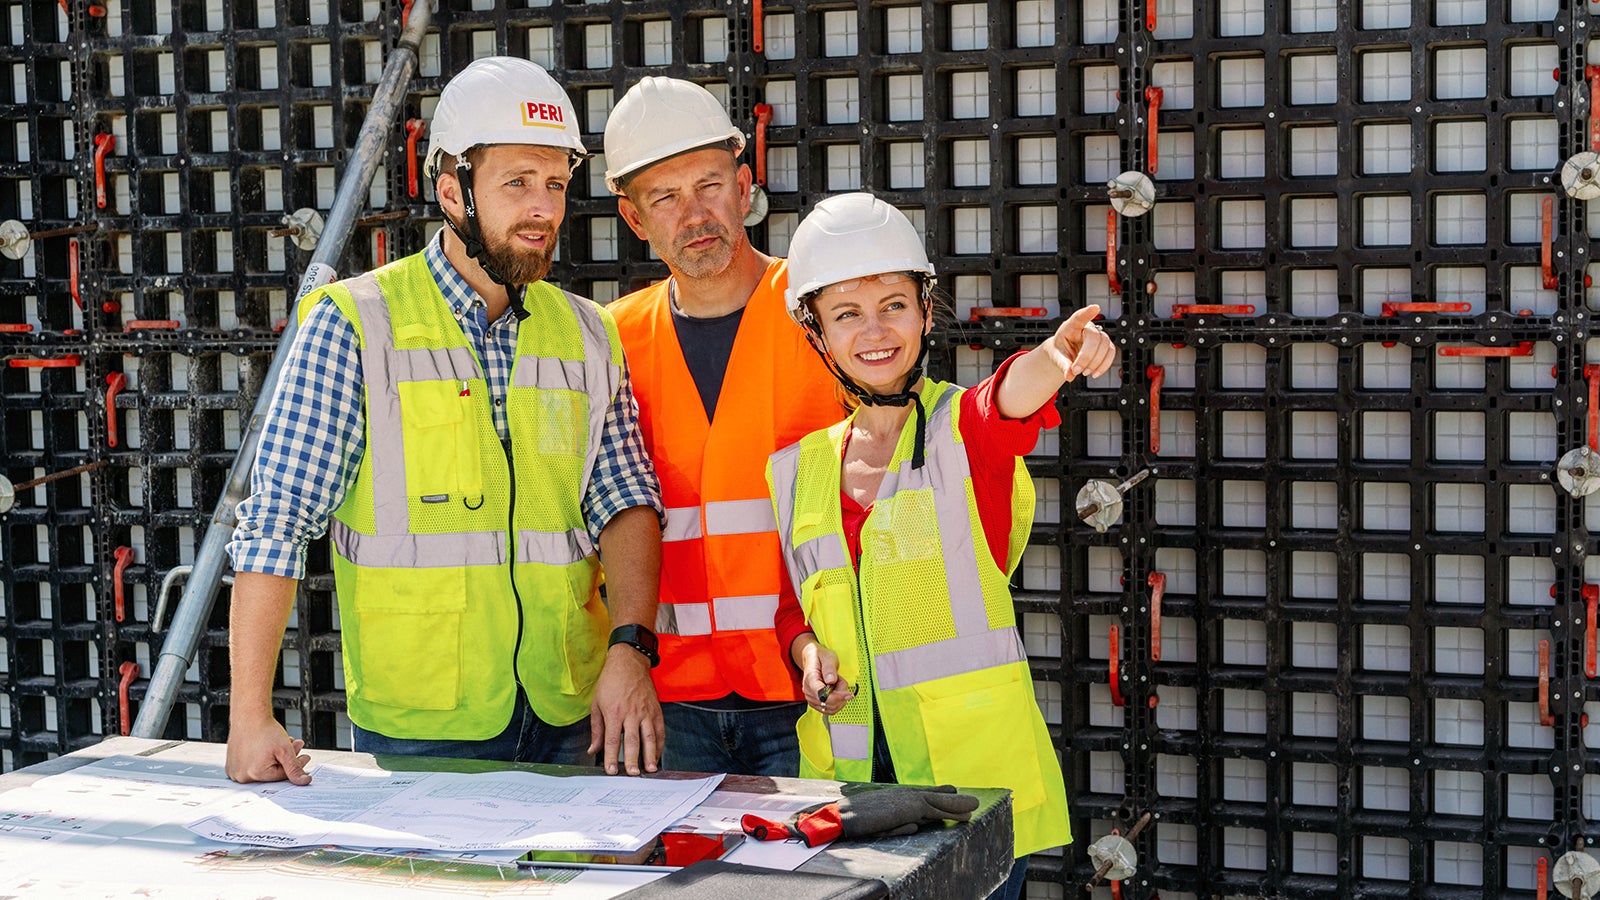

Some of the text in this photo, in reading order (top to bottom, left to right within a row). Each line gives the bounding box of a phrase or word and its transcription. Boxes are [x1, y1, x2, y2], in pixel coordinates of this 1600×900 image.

[526, 102, 563, 122] PERI
[307, 265, 320, 282] 300
[225, 832, 296, 842] SKANSKA
